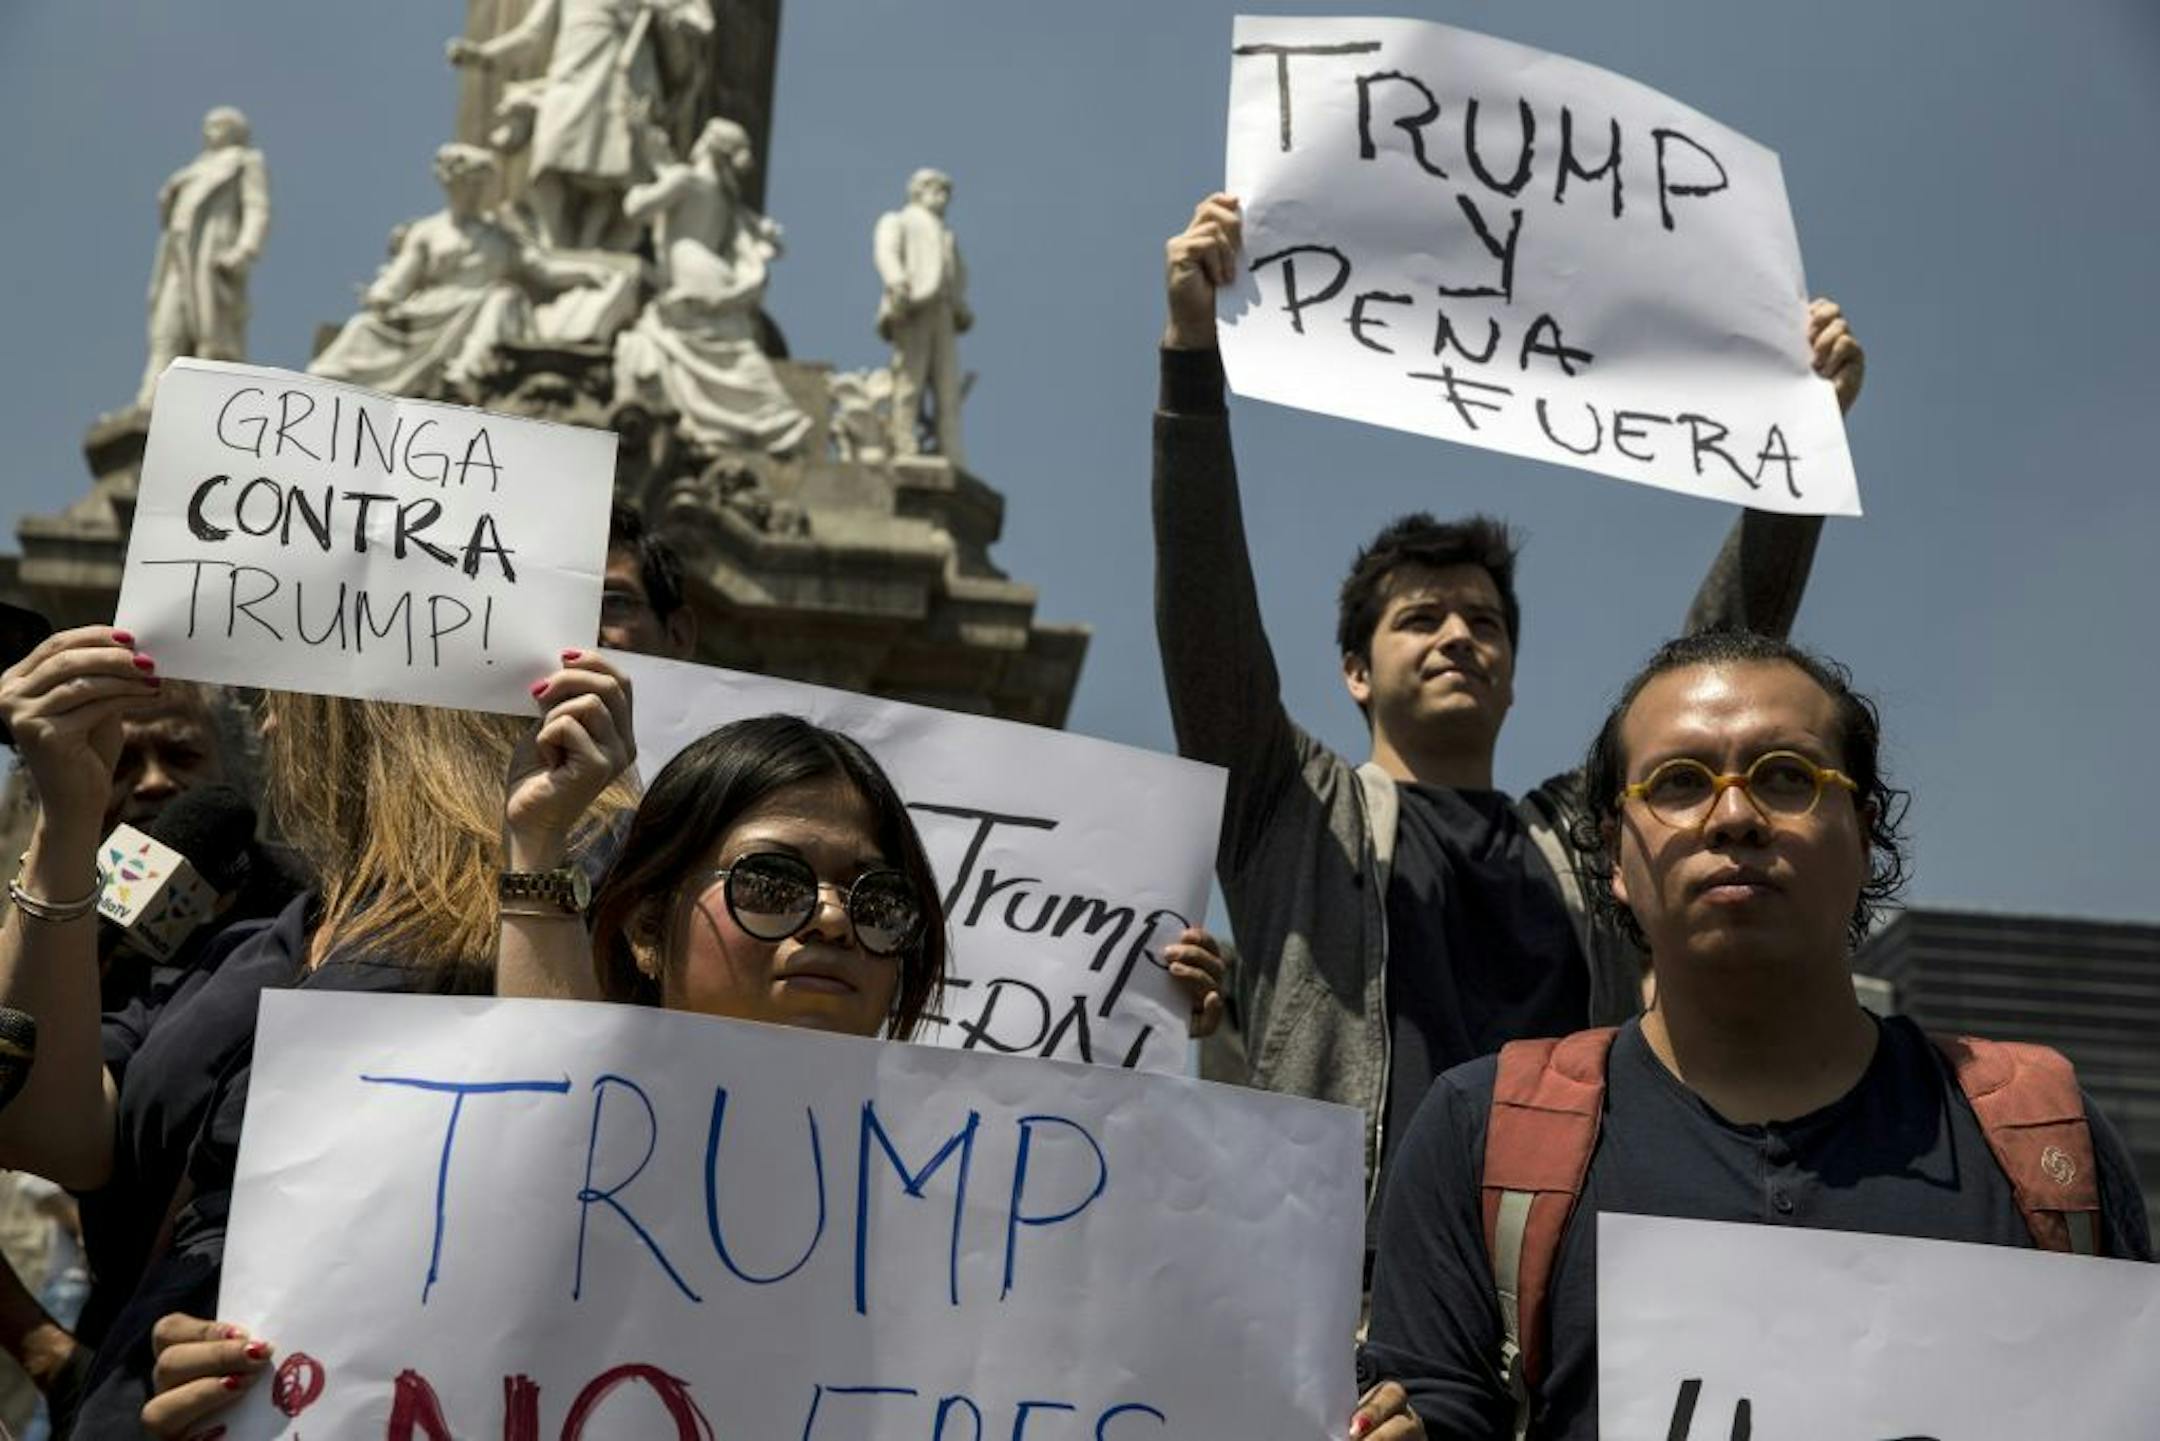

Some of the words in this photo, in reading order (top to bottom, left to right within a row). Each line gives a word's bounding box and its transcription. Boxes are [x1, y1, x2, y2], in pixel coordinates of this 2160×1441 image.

[1233, 40, 1728, 231] TRUMP
[1455, 194, 1523, 304] Y
[216, 387, 503, 491] GRINGA
[1407, 365, 1802, 496] FUERA
[187, 474, 516, 583] CONTRA
[141, 558, 494, 666] TRUMP!
[906, 802, 1190, 1017] Trump
[359, 1073, 1109, 1316] TRUMP
